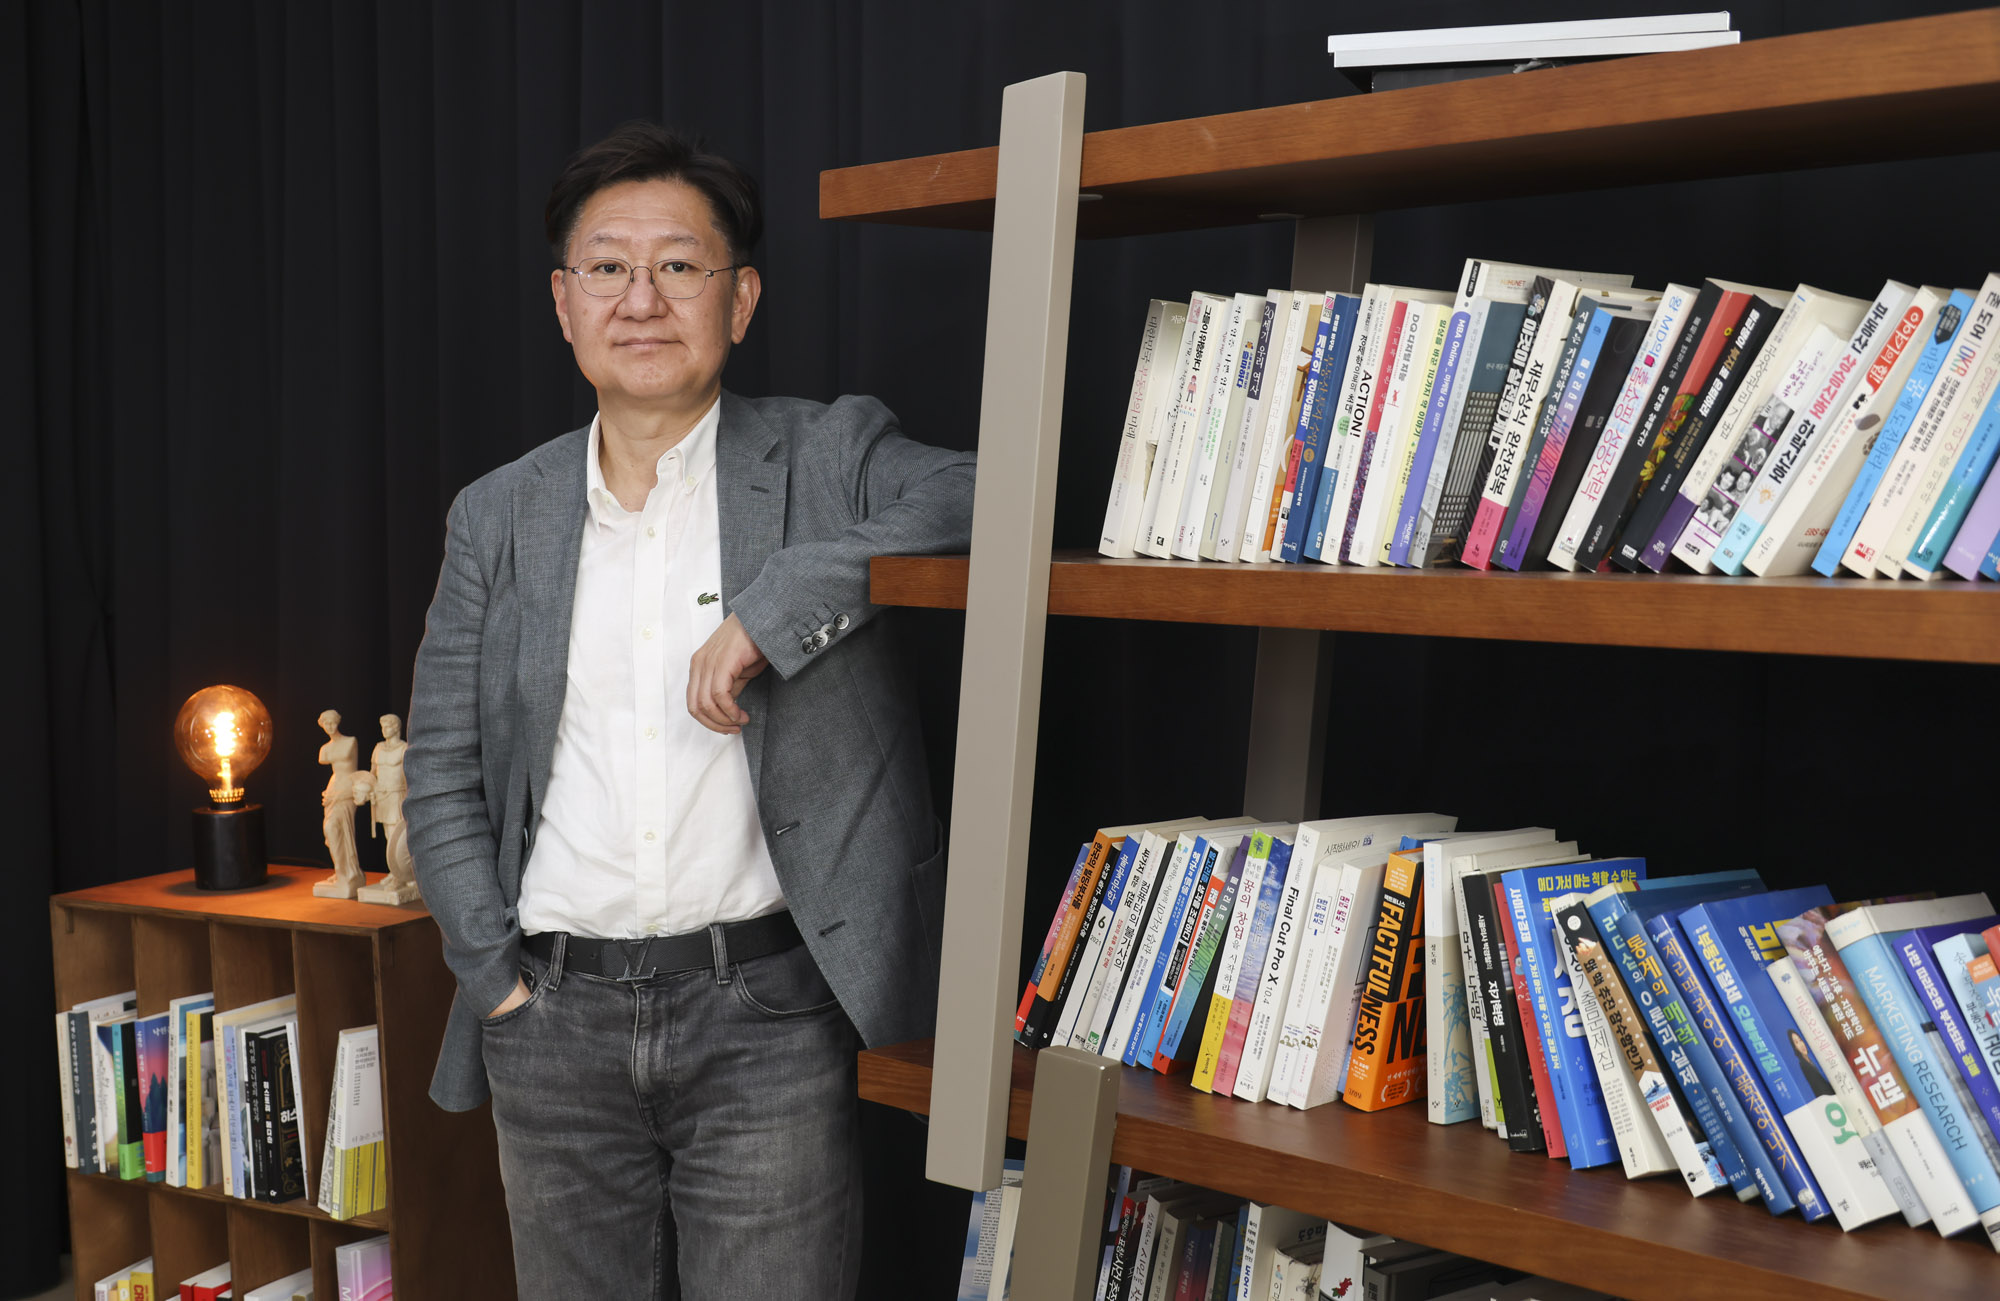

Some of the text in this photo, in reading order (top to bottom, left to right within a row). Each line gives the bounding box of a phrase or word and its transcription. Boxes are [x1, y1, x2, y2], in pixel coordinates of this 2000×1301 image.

[1667, 294, 1683, 311] 왕
[1968, 308, 1993, 340] 도어
[1190, 304, 1211, 372] 그들이 위험하다
[1397, 313, 1420, 382] DQ 디지털 지능
[1434, 319, 1446, 345] 일상을
[1570, 309, 1590, 345] 시체는
[1646, 314, 1673, 357] MD의
[1849, 301, 1888, 354] 부동산
[1879, 308, 1921, 363] 이야기의
[1250, 305, 1275, 396] 20세기 우리 역사
[1429, 347, 1440, 366] 바꾼
[1436, 318, 1465, 407] MBA Online 마케팅 4.0
[1697, 306, 1761, 417] 월급쟁이 부자로 은퇴하라
[1948, 343, 1976, 377] OKR
[1125, 315, 1158, 439] 대한민국 부동산의 미래
[1317, 353, 1335, 392] 부동산
[1421, 368, 1435, 397] 14가지
[1486, 317, 1537, 452] 이것이 실전회계다
[1612, 363, 1651, 424] 홈쇼핑
[1808, 351, 1857, 419] 상승신호
[1311, 395, 1326, 421] 투자
[1349, 369, 1372, 437] ACTION!
[1412, 411, 1424, 437] 이야기
[1863, 345, 1942, 478] 미친 꿈에 도전하라
[1488, 358, 1545, 497] 재무상식 완전정복
[1578, 425, 1624, 502] 성공전략
[1767, 416, 1817, 484] 하락신호
[1070, 840, 1104, 910] 한국의 빌딩부자들
[1134, 846, 1150, 874] 싸가지
[1174, 854, 1183, 862] 말
[1198, 849, 1217, 885] 알고리즘,
[1123, 890, 1135, 908] 진보
[1127, 879, 1150, 925] 컴퓨터의
[1159, 882, 1172, 903] 사람의
[1191, 883, 1206, 908] 생각을
[1537, 869, 1637, 892] 어디 가서 아는 척할 수 있는
[1096, 914, 1107, 929] 6
[1147, 902, 1167, 933] 10가지
[1202, 908, 1211, 919] 나는
[1508, 885, 1533, 944] 사이다경제
[1112, 926, 1134, 971] 불가사의
[1140, 931, 1158, 955] 습관
[1220, 878, 1255, 993] 꿈의 창업을 시작하라
[1261, 885, 1300, 1004] Final Cut Pro X 10.4
[1476, 914, 1493, 969] 시골의사 박경철의
[1524, 946, 1536, 962] 어디
[1354, 901, 1404, 1056] FACTFULNESS
[1528, 962, 1539, 978] 가서
[1532, 977, 1543, 994] 아는
[1582, 957, 1597, 973] 왜
[1588, 971, 1604, 987] 핵
[1486, 979, 1504, 1026] 자기혁명
[1595, 985, 1616, 1012] 추진
[1625, 932, 1698, 1050] 통계의 매력
[1695, 930, 1726, 973] 부동산
[1714, 969, 1742, 1004] 절세
[1731, 1000, 1769, 1056] 오늘부터
[1758, 1050, 1782, 1076] 1일
[1800, 949, 1855, 1041] 바꾸는 새로운 패권 지도
[1902, 942, 1968, 1054] 나만 따라오면 부자되는
[1540, 1011, 1549, 1021] 수
[1545, 1037, 1557, 1053] 경제
[1549, 1053, 1561, 1069] 지식
[1607, 1009, 1646, 1072] 잠수함인가
[1666, 1046, 1699, 1089] 실제
[1849, 1039, 1905, 1111] 뉴맵
